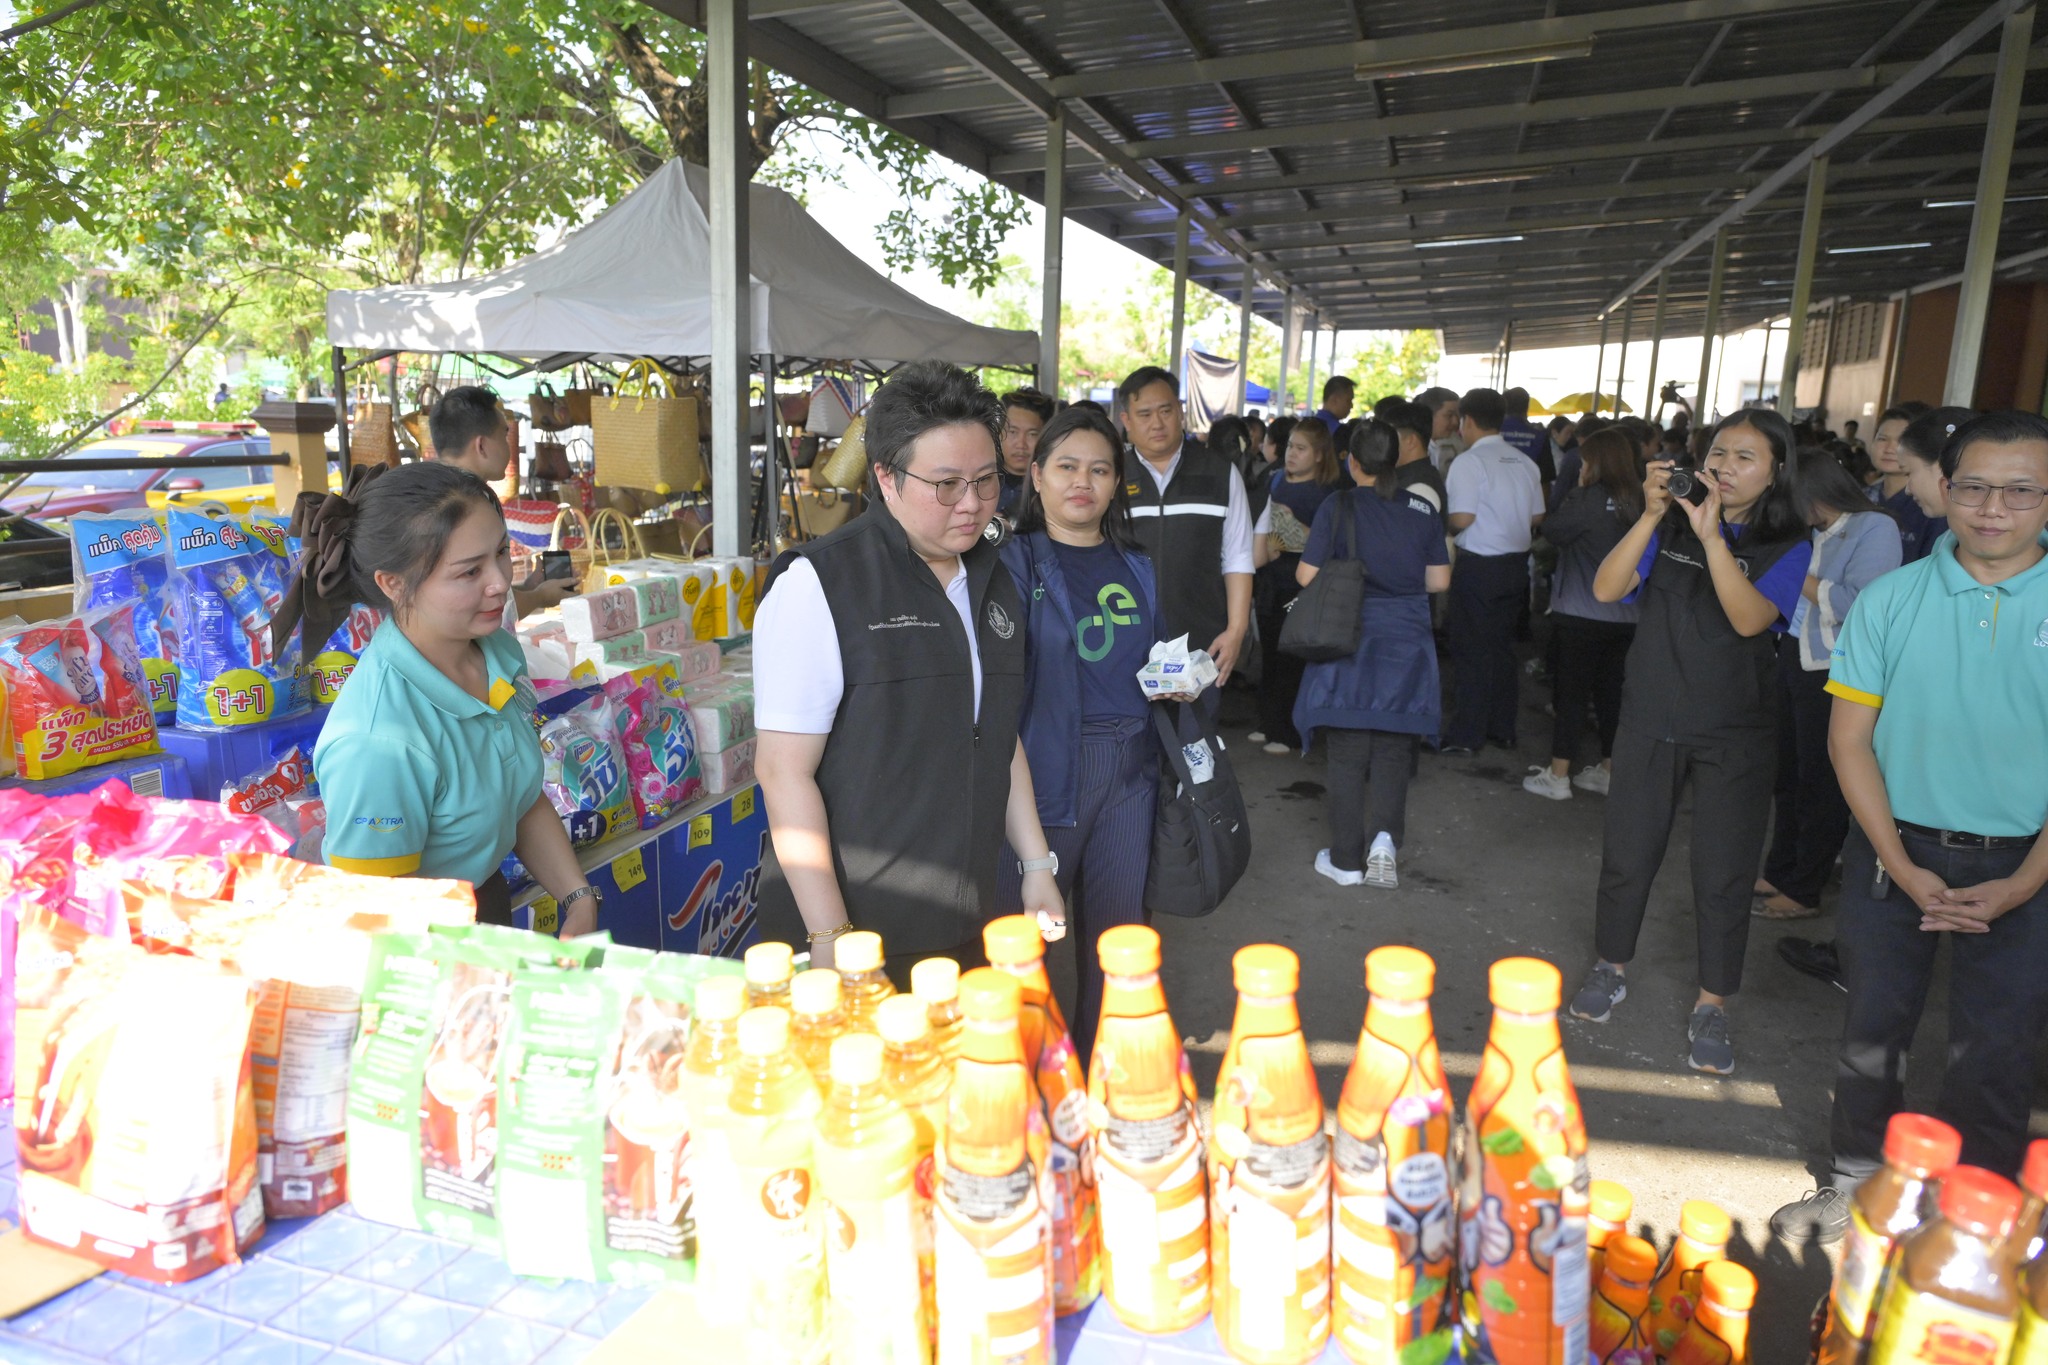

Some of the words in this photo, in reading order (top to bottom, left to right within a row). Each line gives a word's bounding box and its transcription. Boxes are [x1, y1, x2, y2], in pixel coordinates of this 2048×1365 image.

[88, 534, 122, 557] แพ็ค
[121, 523, 162, 555] สุดคุ้ม
[181, 528, 216, 551] แพ็ค
[214, 685, 265, 717] 1+1
[41, 708, 86, 731] แพ็ก
[40, 731, 68, 761] 3
[71, 709, 153, 753] สุดประหยัด
[741, 800, 751, 812] 28
[355, 817, 368, 825] CP
[368, 817, 404, 826] AXTRA
[693, 828, 710, 841] 109
[628, 863, 643, 877] 149
[537, 913, 556, 928] 109
